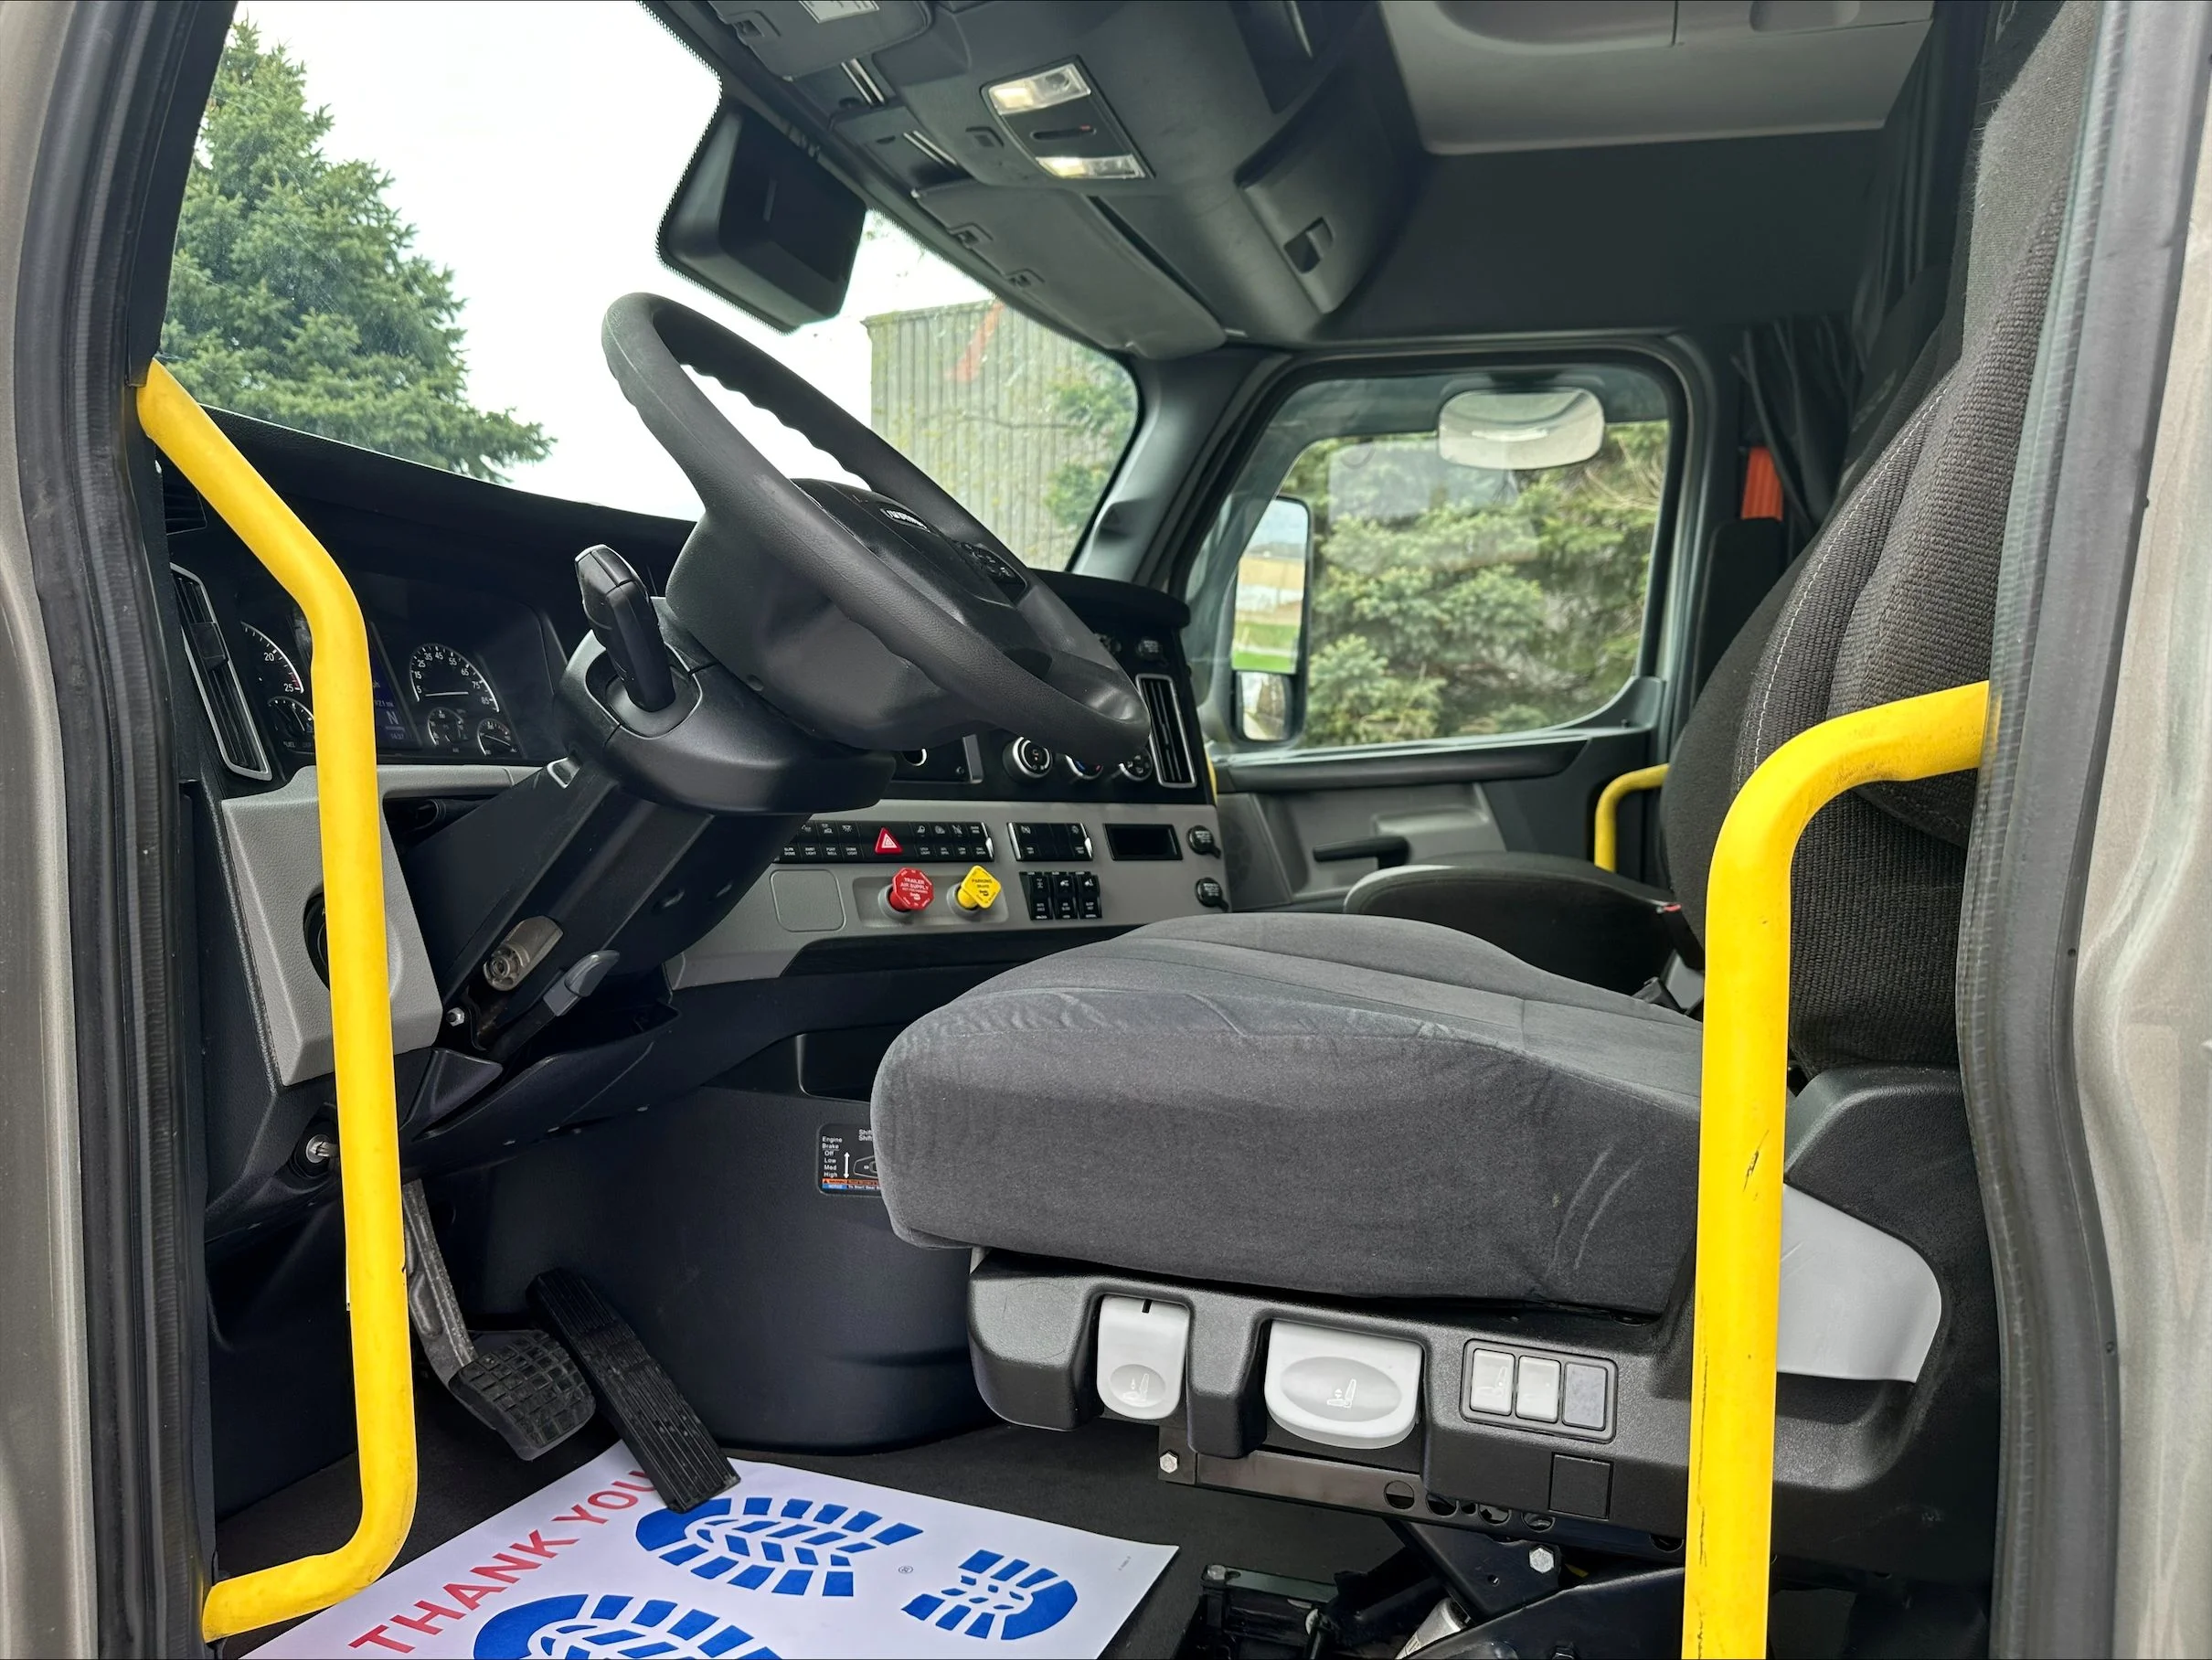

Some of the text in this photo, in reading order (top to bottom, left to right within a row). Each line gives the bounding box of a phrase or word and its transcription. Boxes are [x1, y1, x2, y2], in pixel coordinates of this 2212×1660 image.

[263, 652, 274, 662] 20
[424, 653, 433, 661] 35
[435, 652, 443, 660] 45
[418, 659, 426, 668] 25
[449, 658, 457, 666] 55
[414, 671, 422, 679] 15
[461, 668, 469, 676] 65
[283, 684, 293, 692] 25
[472, 681, 480, 689] 75
[386, 710, 399, 725] N
[349, 1470, 655, 1654] THANK YOU
